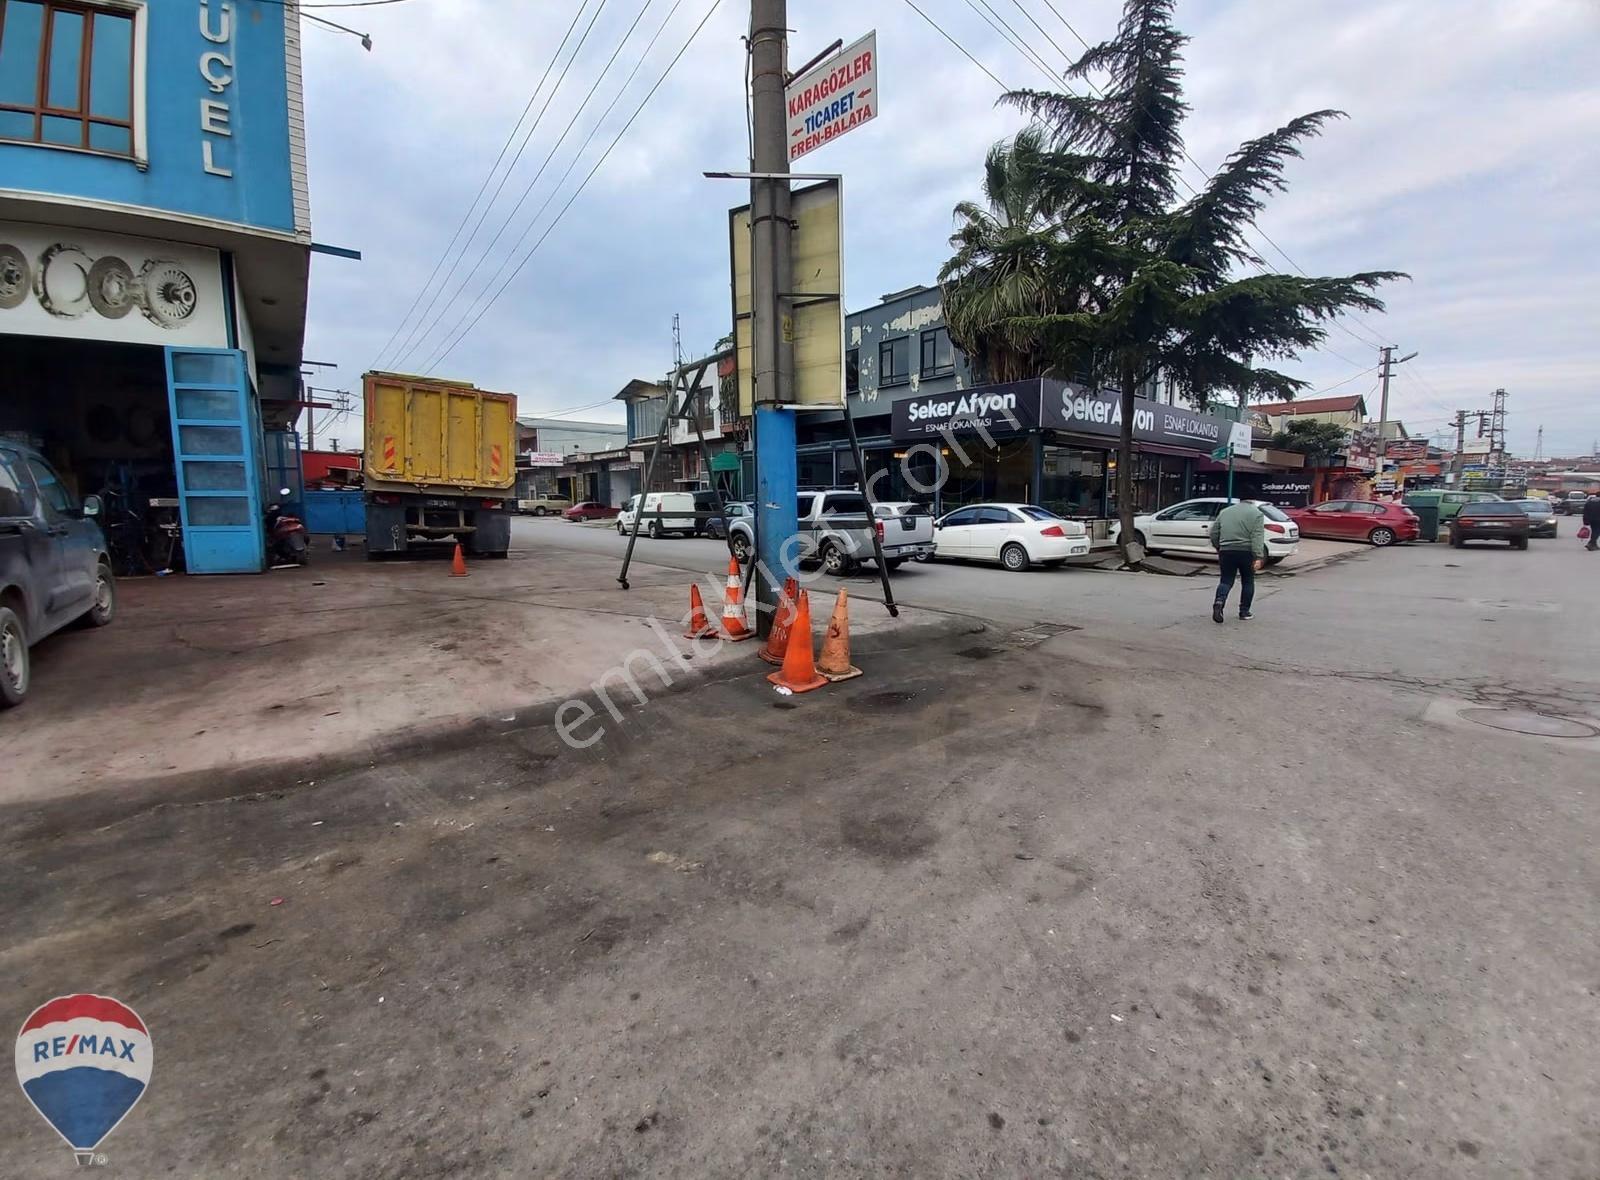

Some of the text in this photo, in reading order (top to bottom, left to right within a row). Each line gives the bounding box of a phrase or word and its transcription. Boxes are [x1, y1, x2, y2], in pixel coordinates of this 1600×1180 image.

[789, 51, 872, 118] KARAGÖZLER
[790, 104, 872, 158] FREN-BALATA
[804, 91, 855, 135] TİCARET
[908, 392, 1016, 422] Şeker Afyon
[1061, 388, 1112, 423] Şeker
[1164, 414, 1218, 438] ESNAF LOKANTASI
